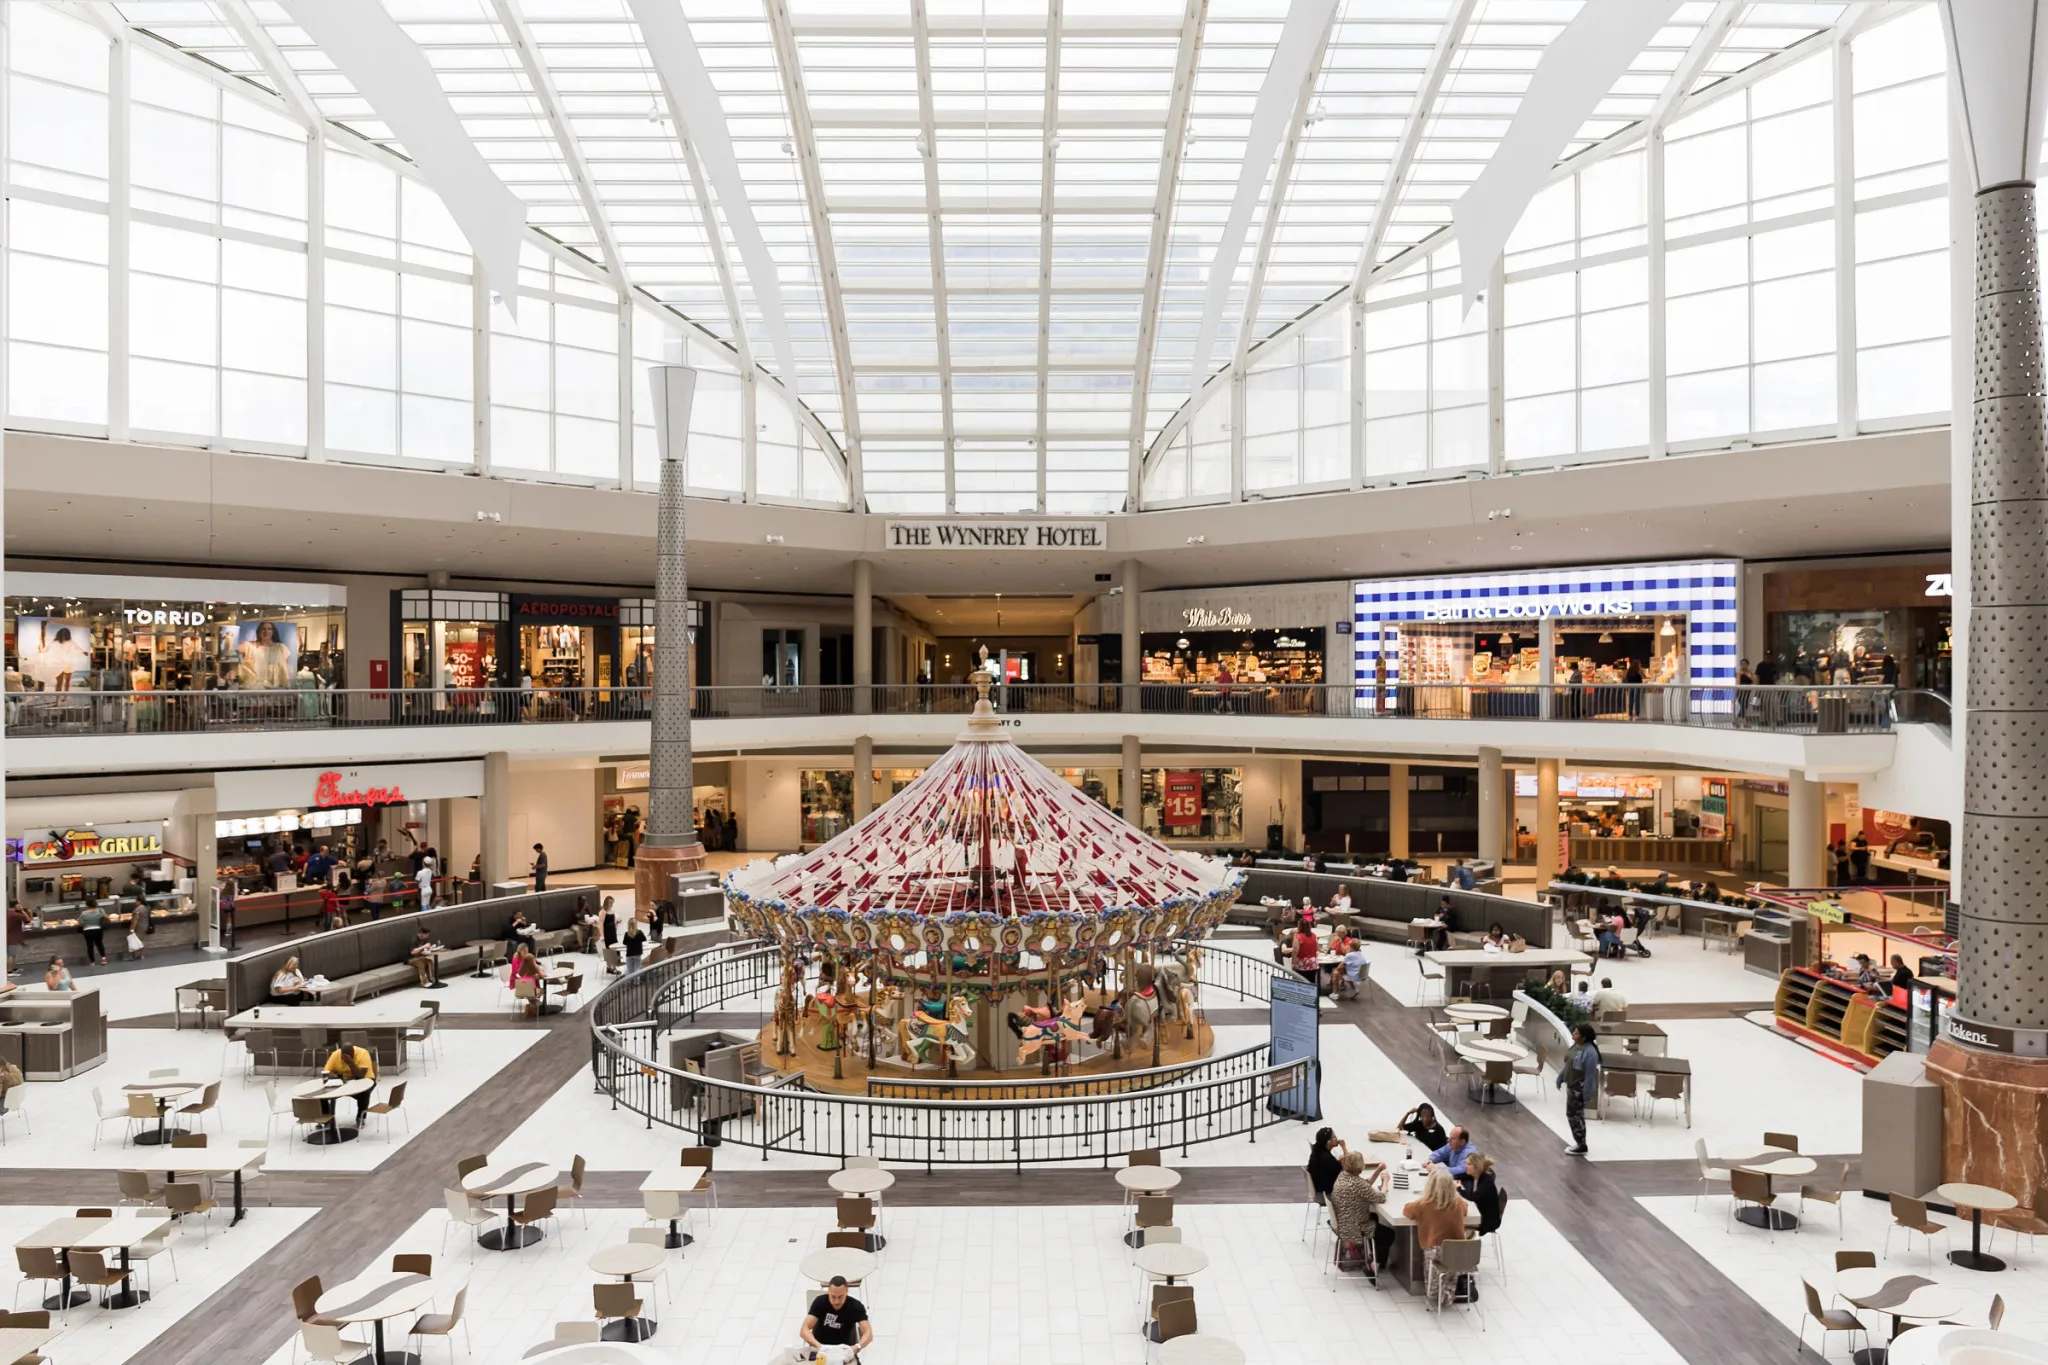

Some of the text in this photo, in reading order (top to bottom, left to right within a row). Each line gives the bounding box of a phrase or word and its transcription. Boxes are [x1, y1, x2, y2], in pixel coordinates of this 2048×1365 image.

[891, 525, 1102, 546] THE WYNFREY HOTEL
[123, 609, 205, 626] TORRID
[1424, 596, 1632, 621] Bath & Body Works
[456, 675, 476, 686] OFF
[1166, 797, 1196, 816] $15
[101, 836, 161, 855] GRILL
